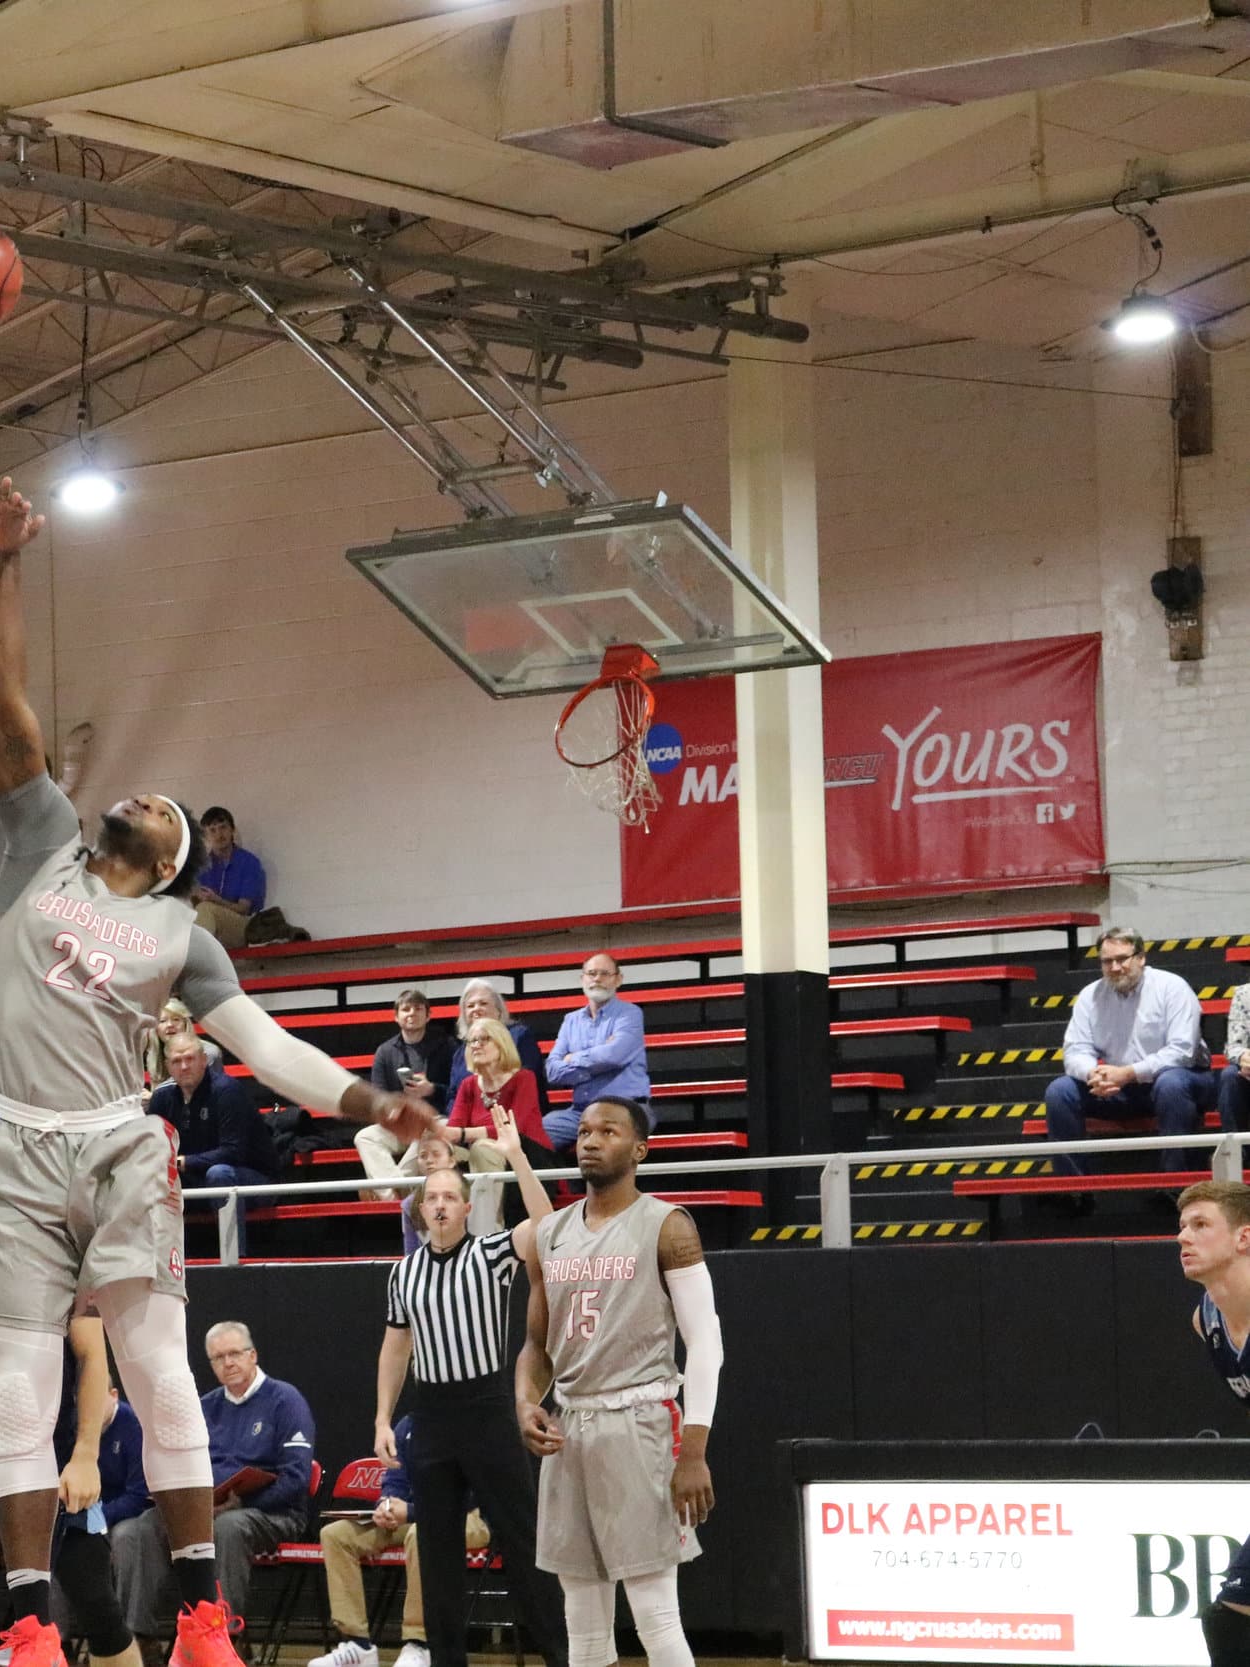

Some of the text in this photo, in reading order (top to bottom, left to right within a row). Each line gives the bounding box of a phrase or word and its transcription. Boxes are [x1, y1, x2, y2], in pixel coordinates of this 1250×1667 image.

[646, 746, 682, 763] NCAA
[686, 743, 729, 758] Division
[881, 705, 1070, 811] YOURS
[678, 762, 740, 806] MA
[35, 889, 159, 958] CRUSADERS
[44, 931, 117, 1002] 22
[544, 1256, 638, 1283] CRUSADERS
[566, 1289, 600, 1341] 15
[821, 1502, 1073, 1536] DLK APPAREL
[837, 1617, 1062, 1642] www.ngcrusaders.com
